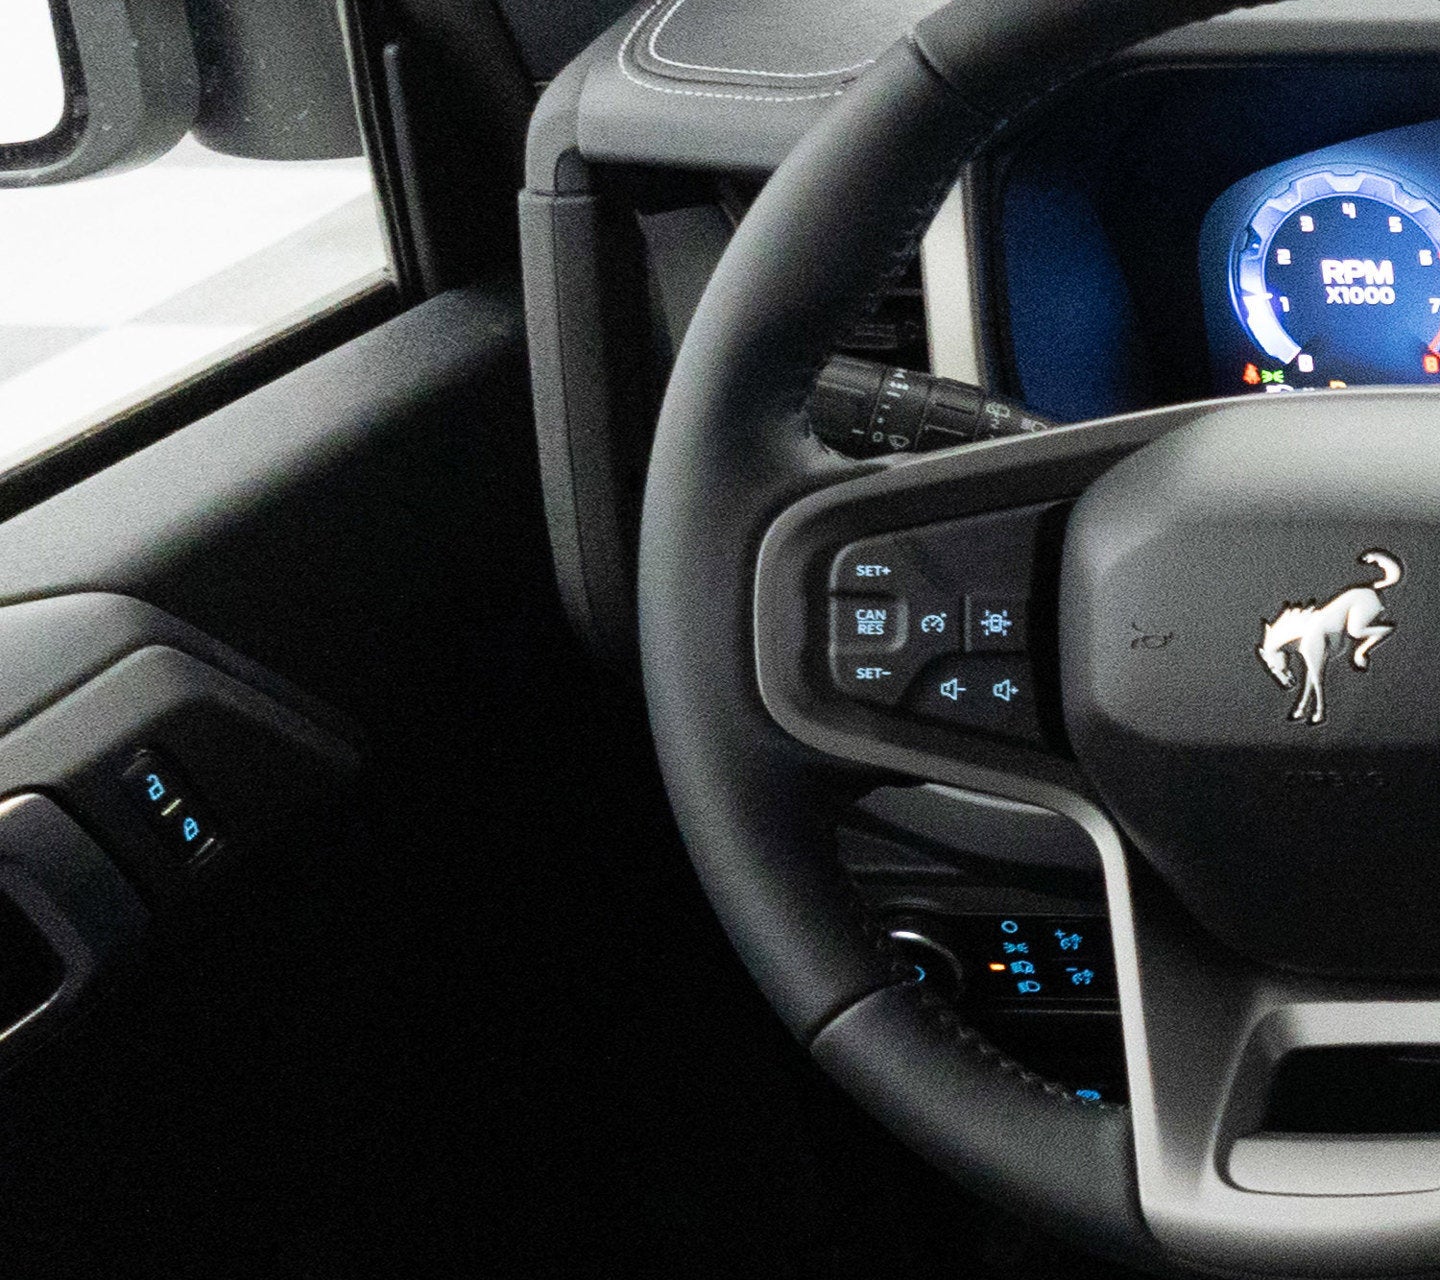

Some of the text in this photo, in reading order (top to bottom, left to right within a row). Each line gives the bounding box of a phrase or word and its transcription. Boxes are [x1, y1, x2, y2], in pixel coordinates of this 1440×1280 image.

[1342, 202, 1356, 218] 4
[1300, 216, 1314, 232] 3
[1388, 216, 1402, 233] 5
[1277, 249, 1291, 265] 2
[1419, 249, 1433, 265] 6
[1321, 259, 1394, 285] RPM
[1325, 286, 1395, 304] X1000
[1279, 296, 1289, 312] 1
[1429, 297, 1440, 313] 7
[856, 564, 892, 578] SET+
[855, 609, 887, 621] CAN
[857, 624, 885, 635] RES
